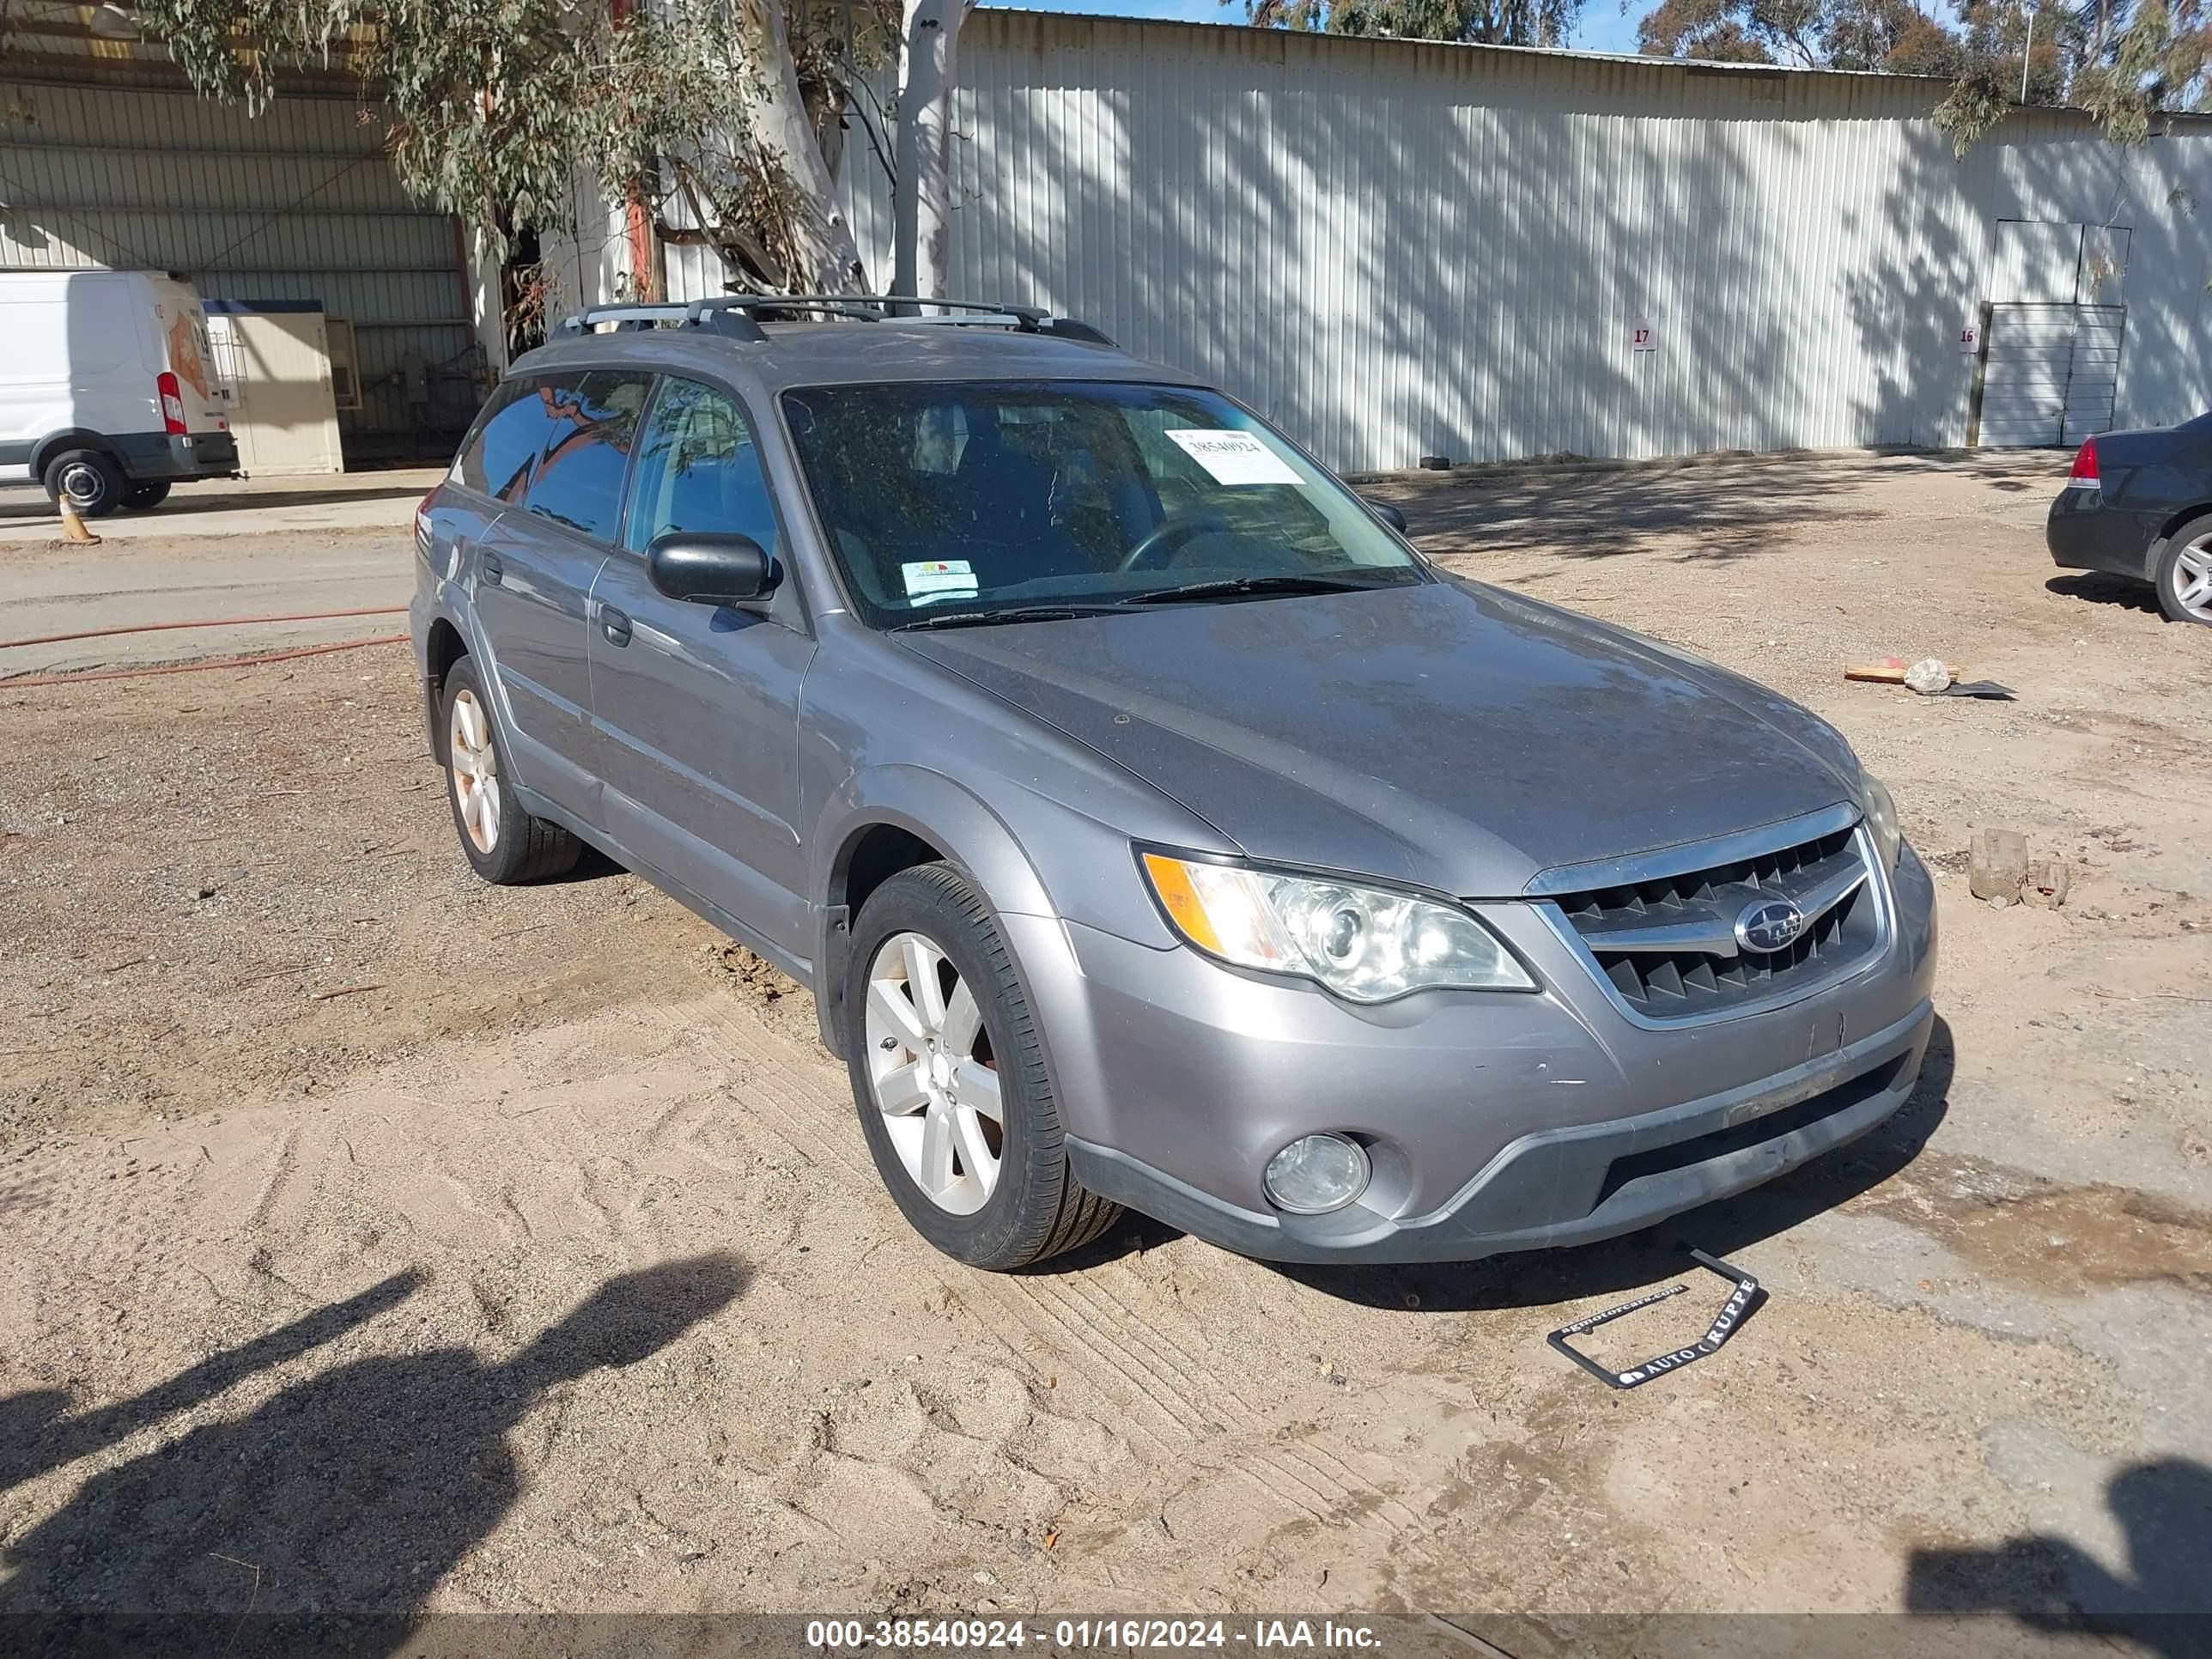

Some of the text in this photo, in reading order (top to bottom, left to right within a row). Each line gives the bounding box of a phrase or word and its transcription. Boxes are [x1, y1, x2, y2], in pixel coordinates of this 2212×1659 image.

[1635, 330, 1650, 343] 17
[1960, 330, 1974, 343] 16
[1189, 441, 1261, 453] 38540924
[1560, 1284, 1685, 1334] agmotorcars.com
[1645, 1349, 1696, 1375] AUTO
